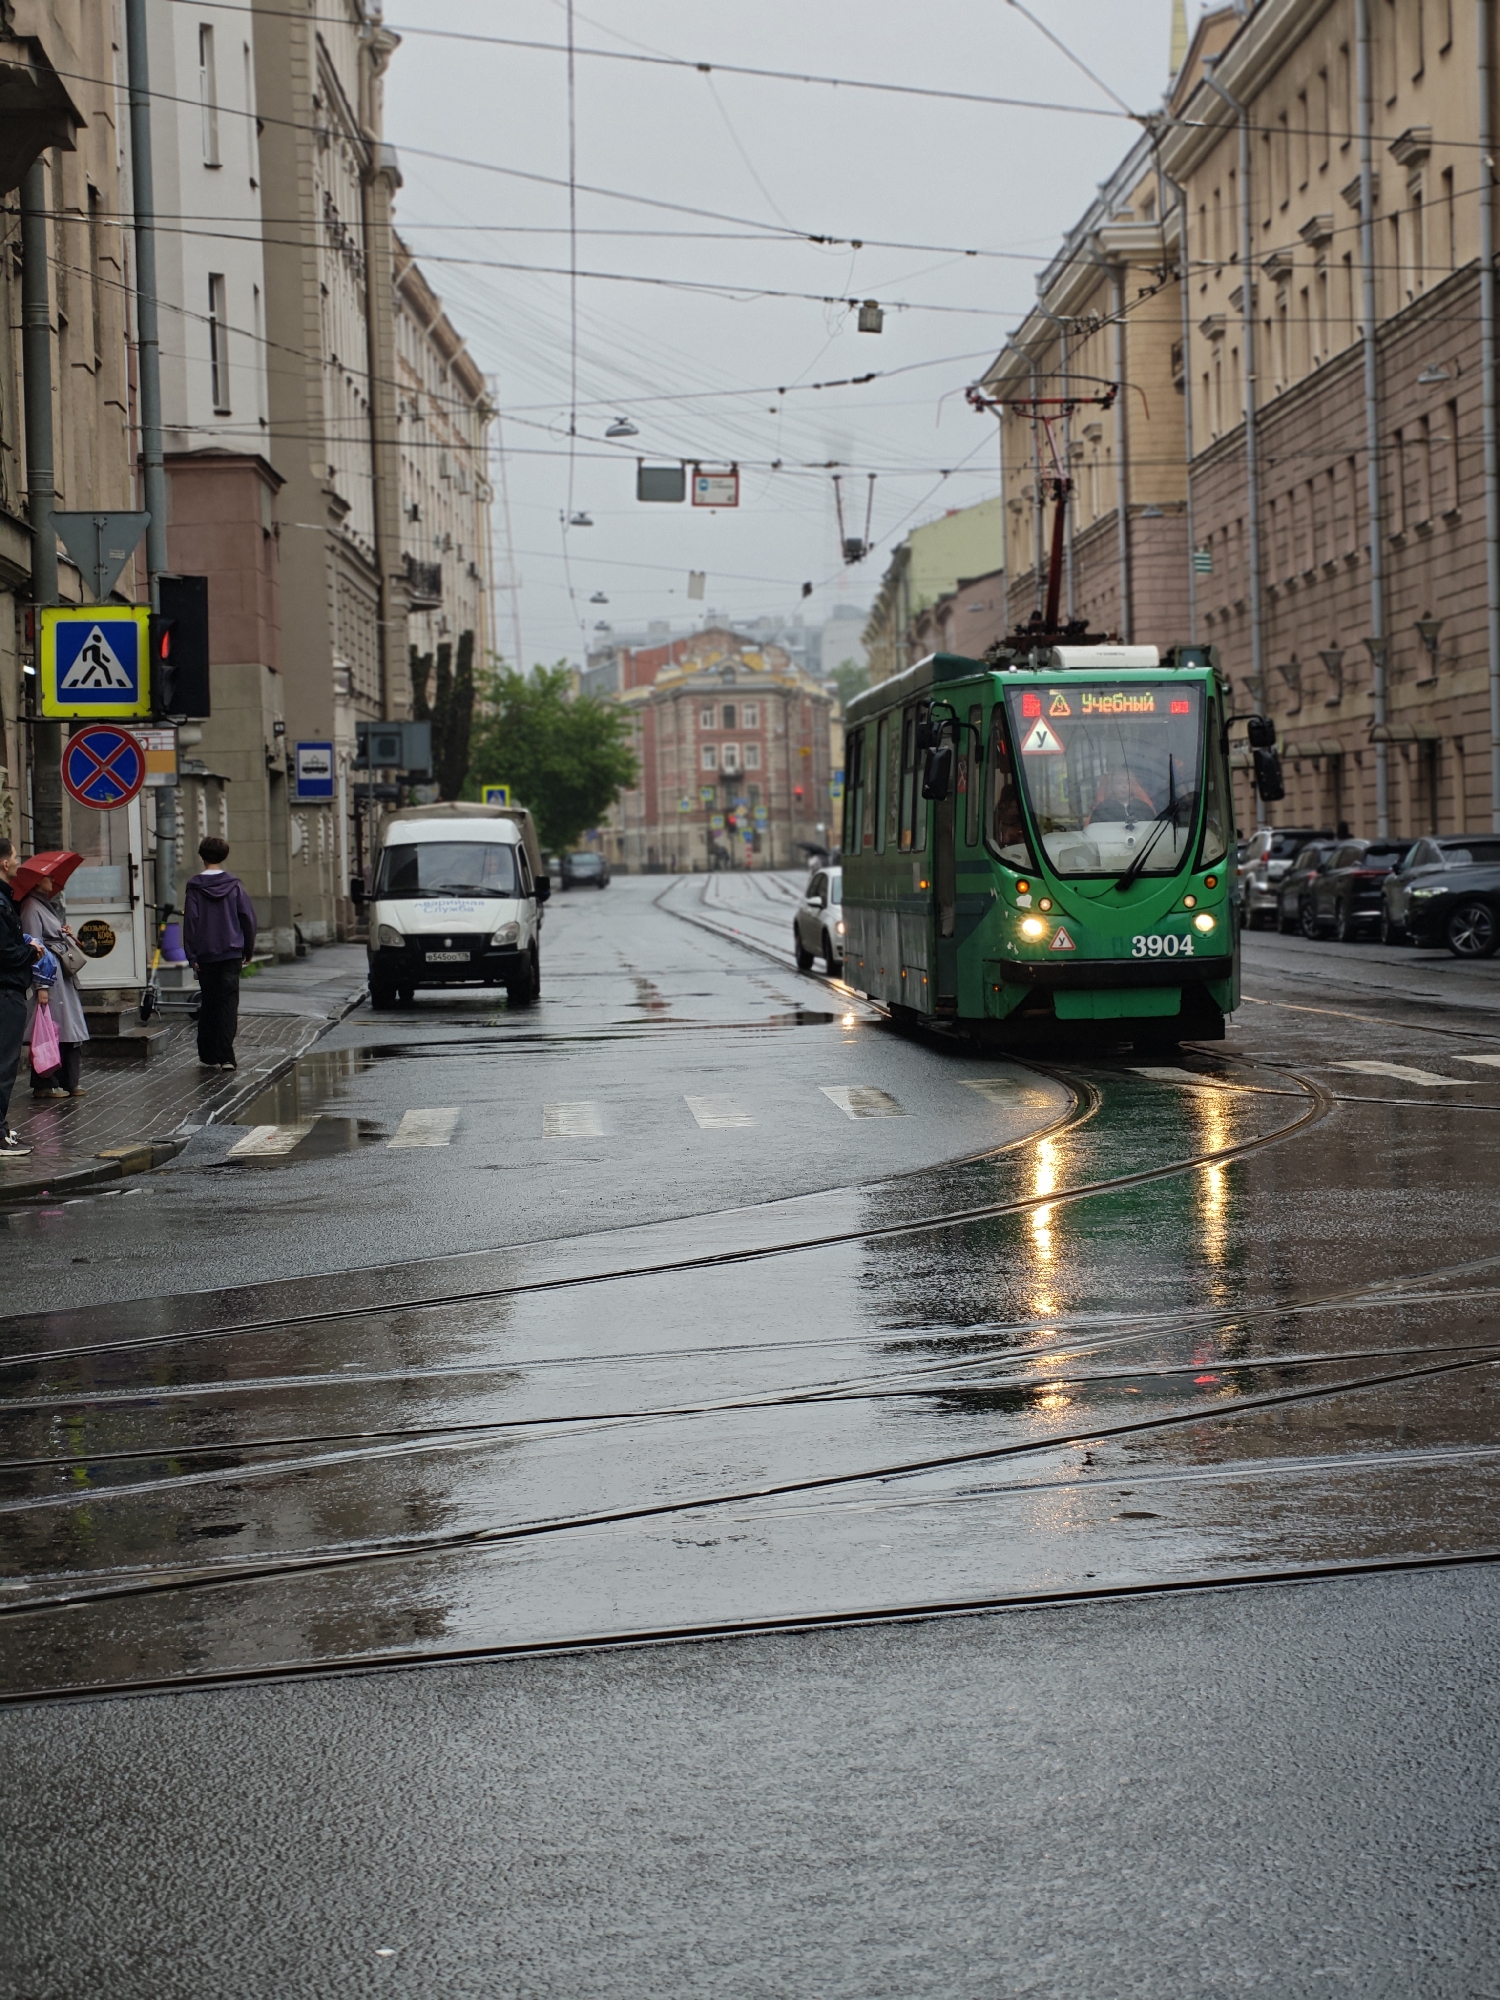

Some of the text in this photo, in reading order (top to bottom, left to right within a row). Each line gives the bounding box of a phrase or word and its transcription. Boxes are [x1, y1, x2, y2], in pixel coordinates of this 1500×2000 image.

[1081, 692, 1155, 713] Учебный
[1036, 730, 1047, 748] У
[424, 905, 474, 914] Служба
[98, 931, 114, 940] КОФЕ
[1132, 934, 1194, 957] 3904
